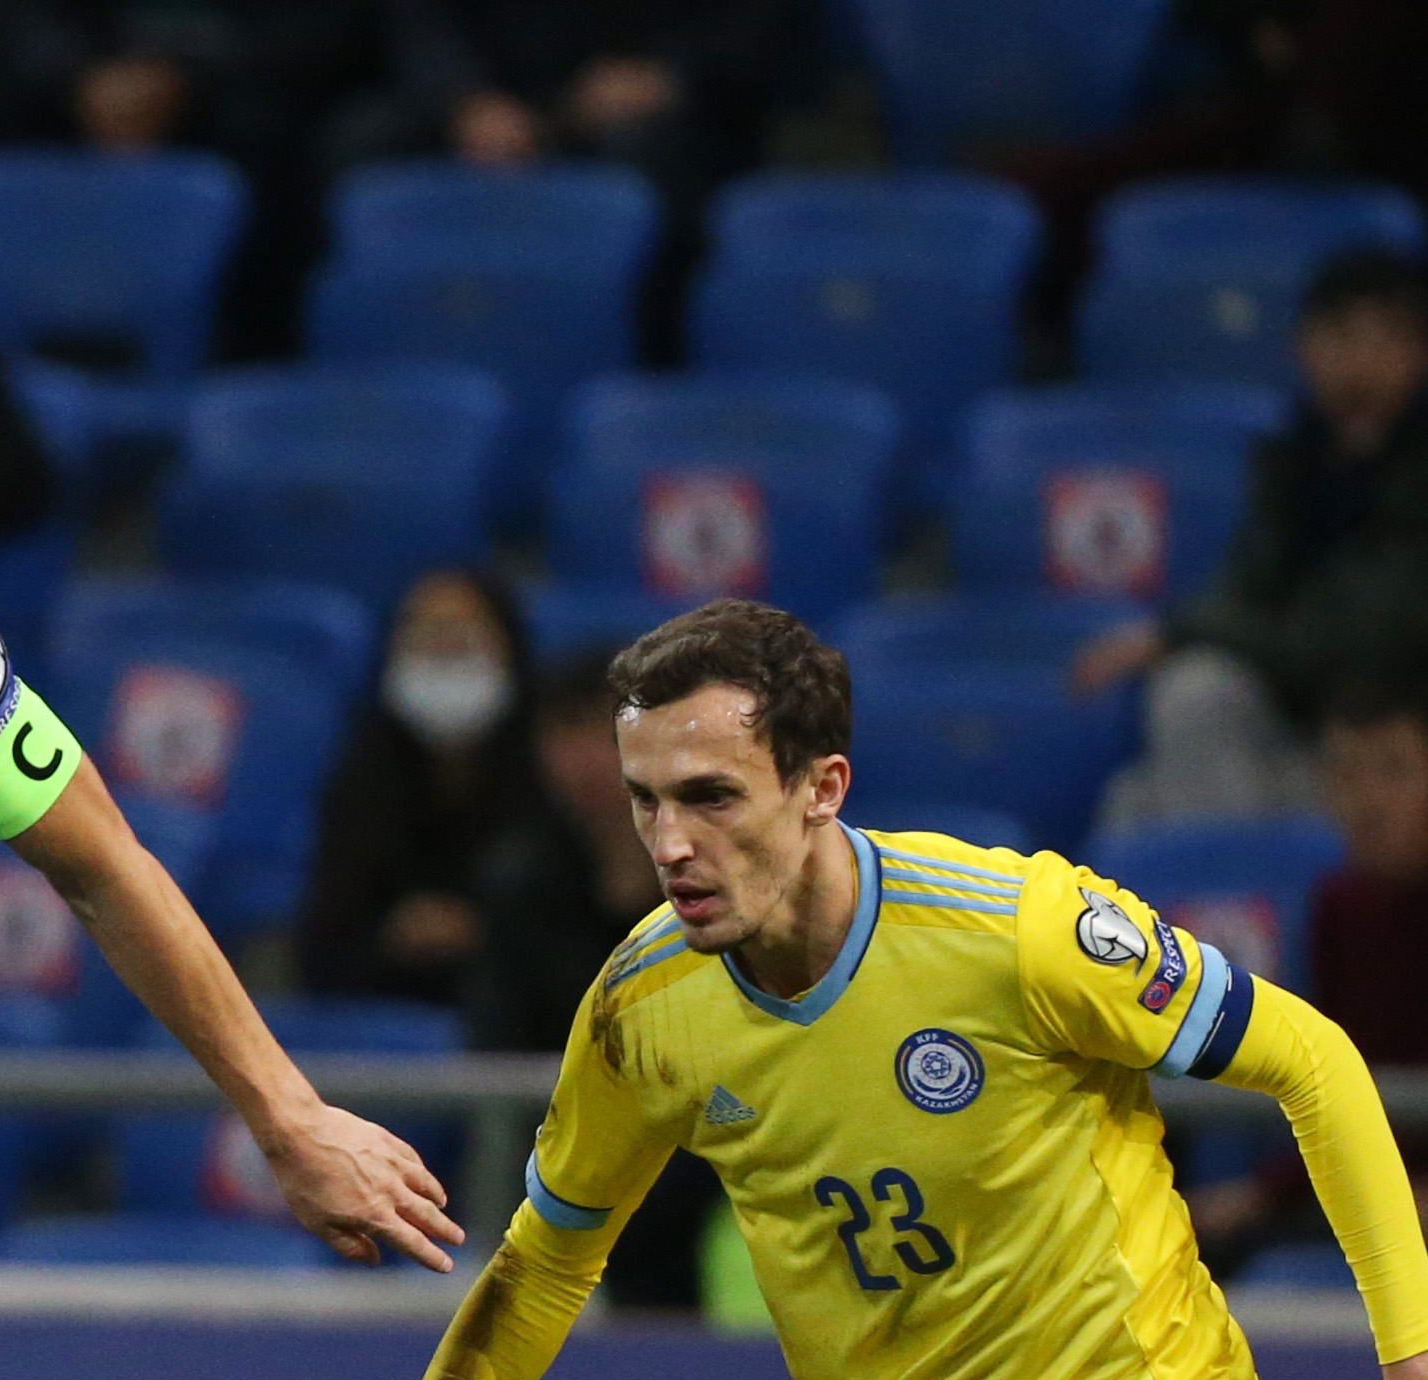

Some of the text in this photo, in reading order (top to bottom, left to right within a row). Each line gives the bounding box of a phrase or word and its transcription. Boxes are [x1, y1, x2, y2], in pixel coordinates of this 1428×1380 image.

[12, 720, 63, 781] C
[1156, 919, 1182, 983] RESPECT
[915, 1033, 940, 1045] KFF
[704, 1105, 757, 1125] adidas
[814, 1168, 957, 1291] 23
